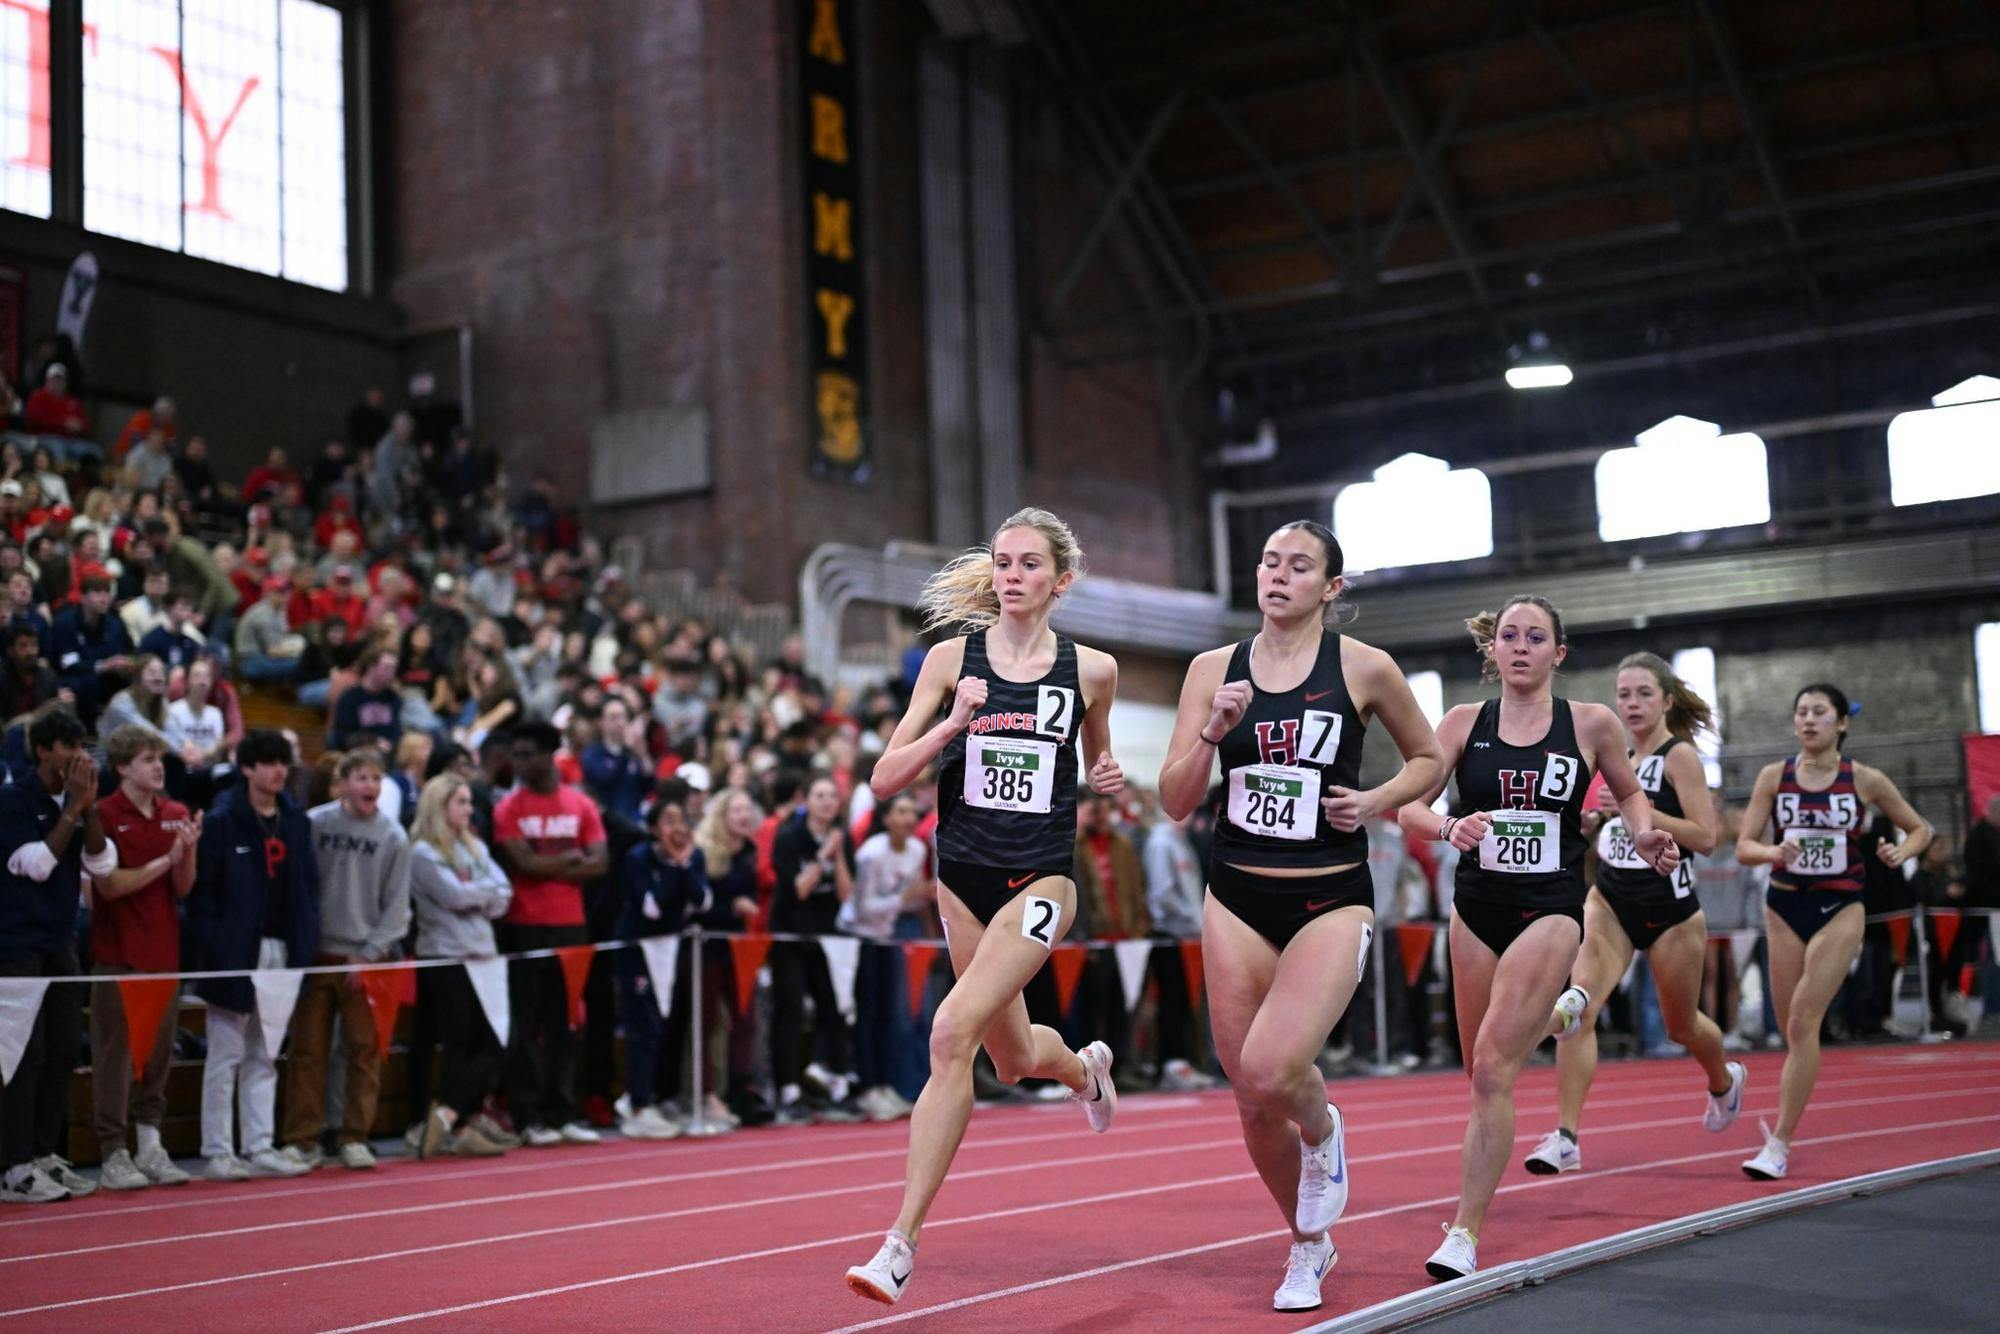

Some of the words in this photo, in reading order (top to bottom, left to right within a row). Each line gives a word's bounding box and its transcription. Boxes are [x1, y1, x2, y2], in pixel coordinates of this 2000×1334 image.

[1043, 689, 1067, 734] 2
[1255, 719, 1300, 767] H
[1309, 714, 1335, 758] 7
[995, 752, 1015, 766] Ivy
[1641, 758, 1659, 788] 4
[983, 767, 1034, 803] 385
[1258, 778, 1277, 793] Ivy
[1498, 769, 1539, 810] H
[1547, 757, 1570, 797] 3
[1245, 791, 1296, 830] 264
[1782, 796, 1794, 824] 5
[1837, 798, 1851, 825] 5
[319, 832, 379, 855] PENN
[1506, 823, 1524, 835] Ivy
[263, 836, 287, 880] P
[1497, 836, 1542, 865] 260
[1608, 838, 1637, 861] 362
[1798, 848, 1833, 869] 325
[1678, 862, 1692, 889] 4
[1029, 900, 1054, 943] 2
